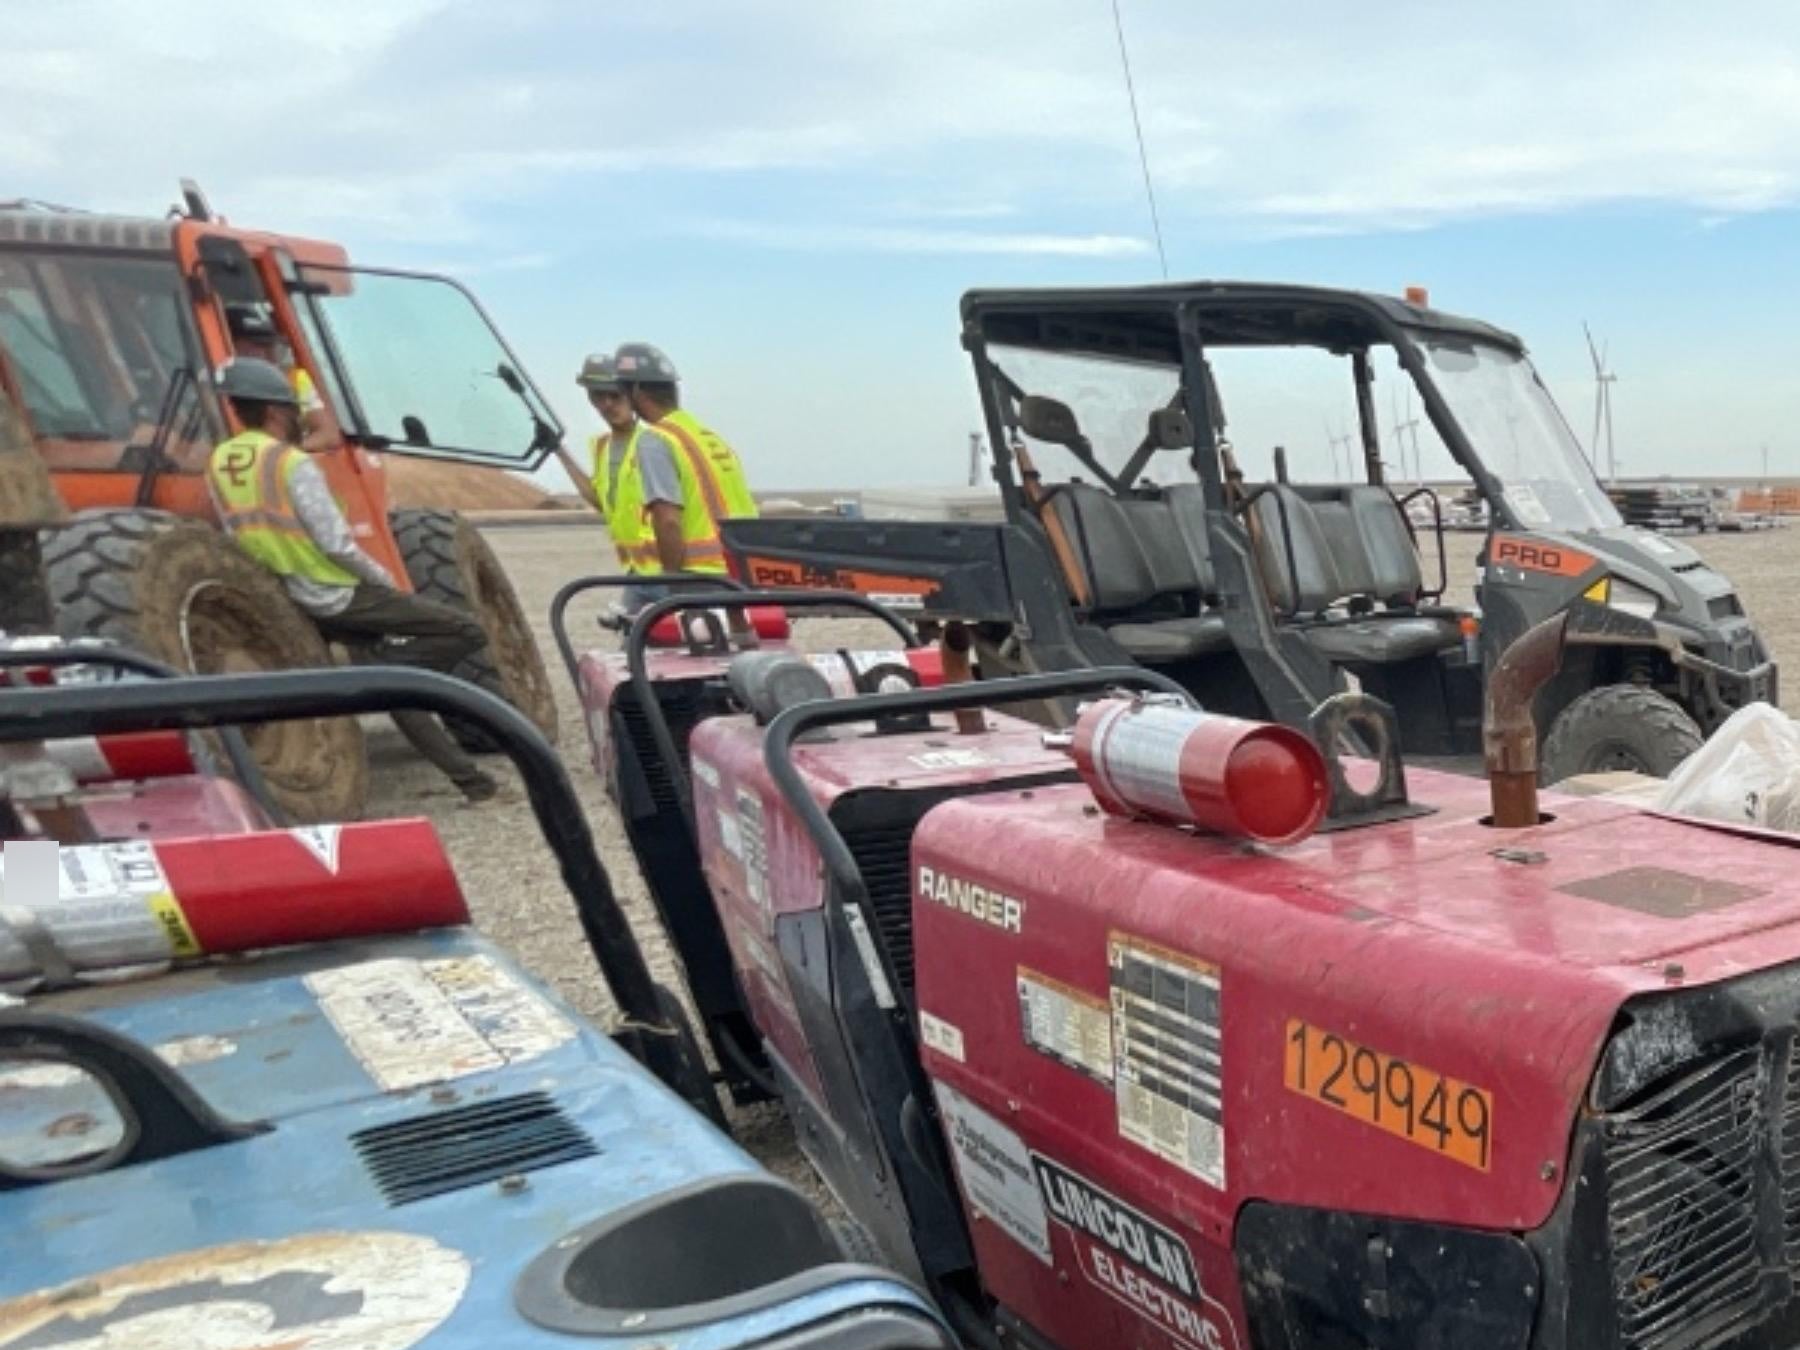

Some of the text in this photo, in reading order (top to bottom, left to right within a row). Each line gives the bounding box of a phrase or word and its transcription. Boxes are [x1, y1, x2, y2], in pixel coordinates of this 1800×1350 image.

[1499, 543, 1562, 568] PRO
[918, 865, 1022, 934] RANGER
[1291, 1023, 1490, 1168] 129949
[1038, 1165, 1194, 1295] LINCOLN
